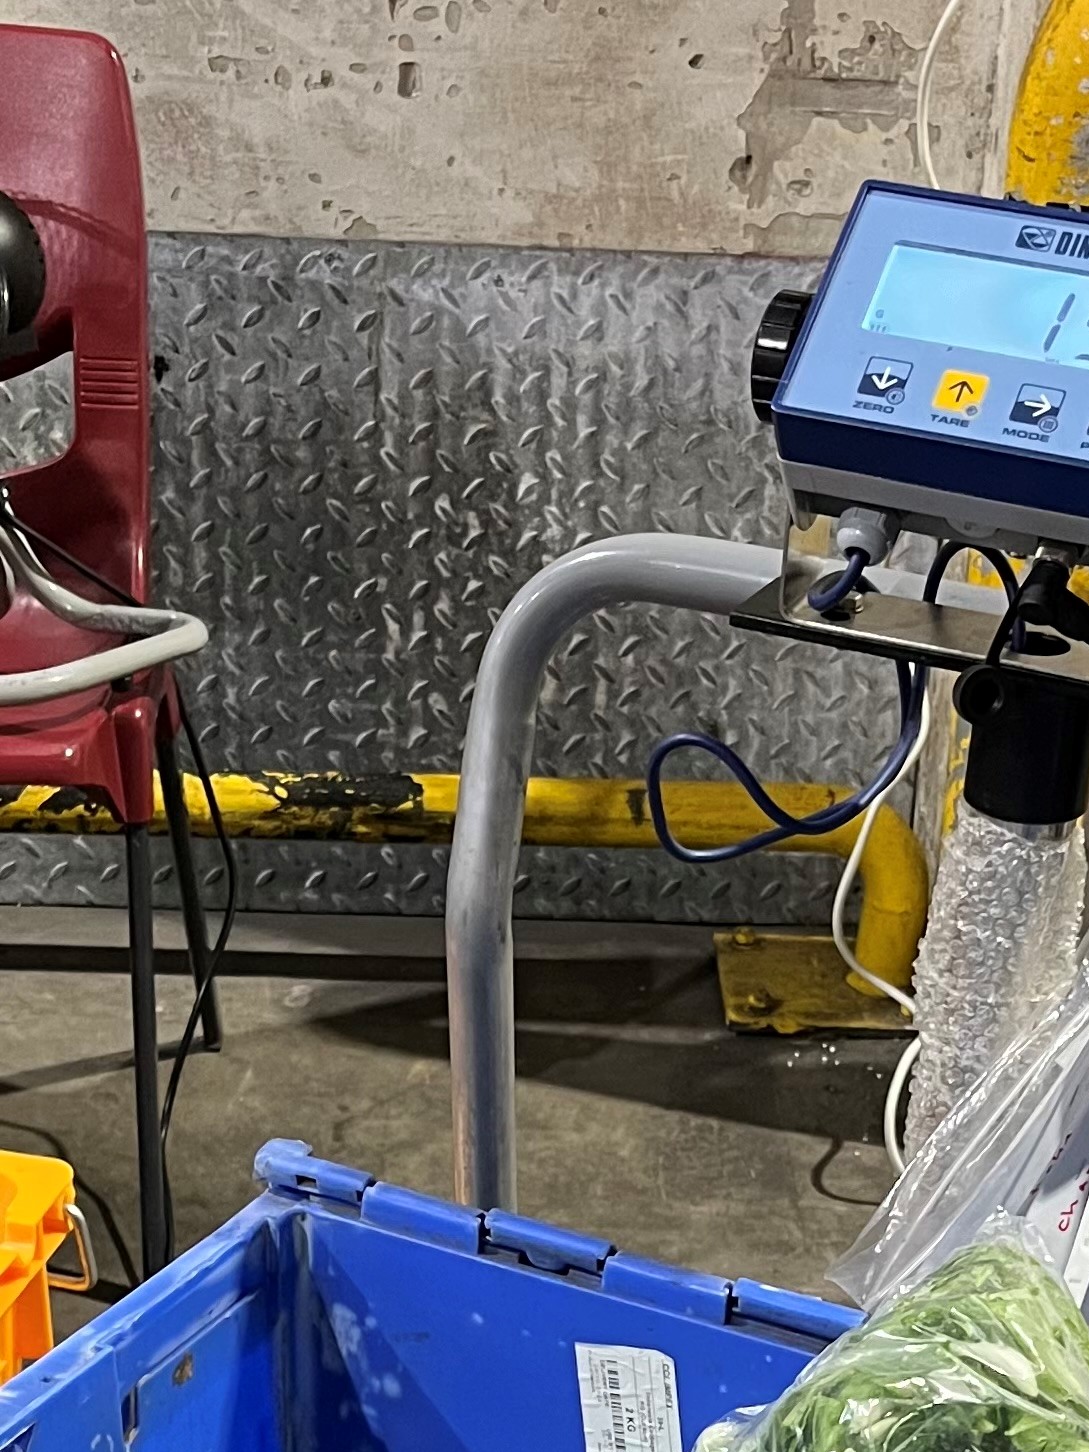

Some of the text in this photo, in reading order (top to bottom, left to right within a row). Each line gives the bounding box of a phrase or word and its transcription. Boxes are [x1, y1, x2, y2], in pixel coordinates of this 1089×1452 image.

[852, 400, 895, 414] ZERO
[930, 414, 970, 428] TARE
[1002, 428, 1050, 443] MODE
[626, 1416, 636, 1433] KG
